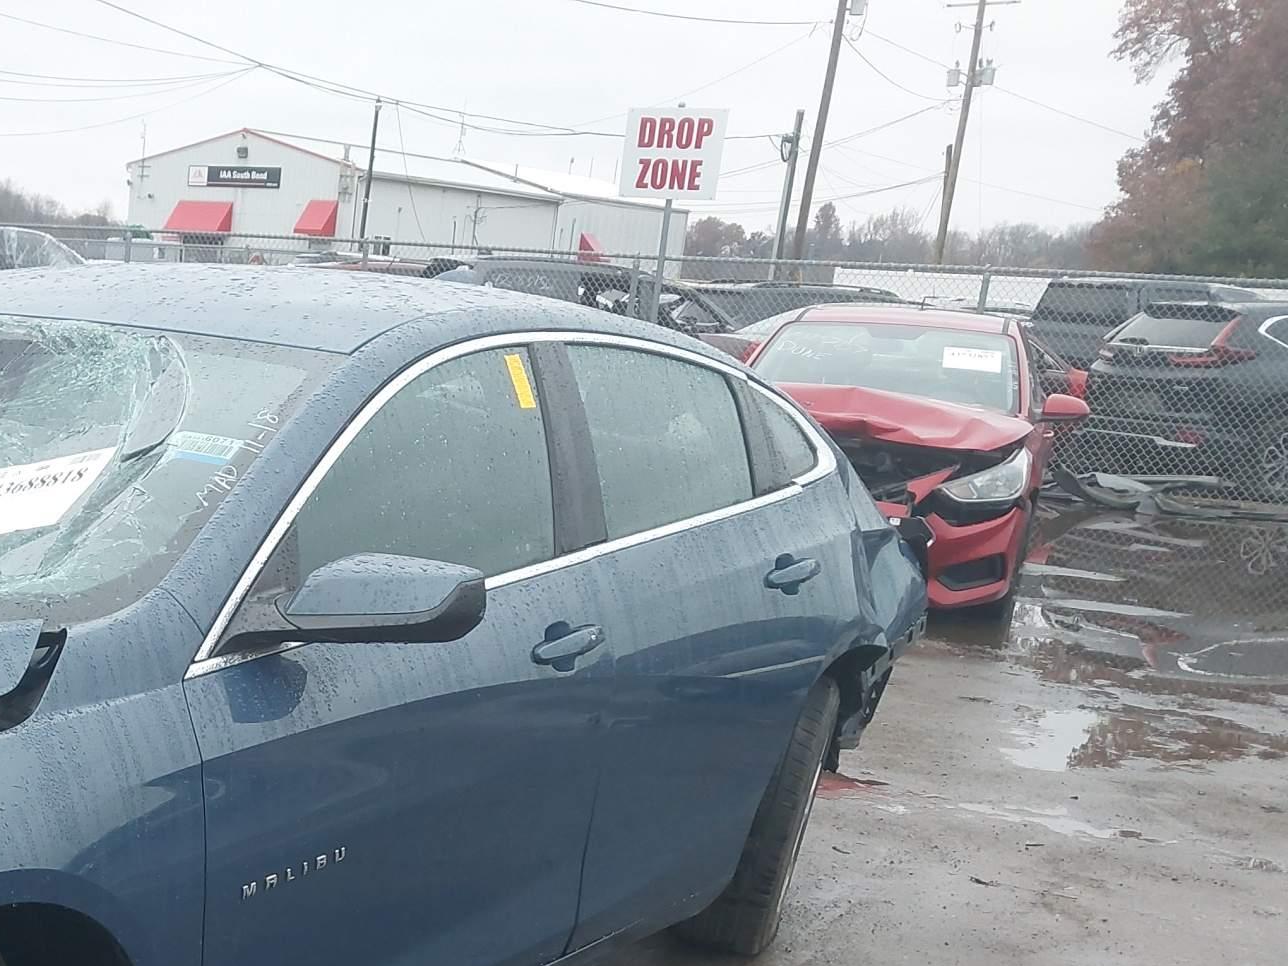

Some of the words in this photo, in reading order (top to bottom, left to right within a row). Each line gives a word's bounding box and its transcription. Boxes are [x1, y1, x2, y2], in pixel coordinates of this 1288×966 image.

[637, 116, 714, 149] DROP
[219, 169, 232, 179] IAA
[635, 158, 703, 190] ZONE
[196, 466, 239, 507] MAD
[242, 847, 346, 900] MALIBU
